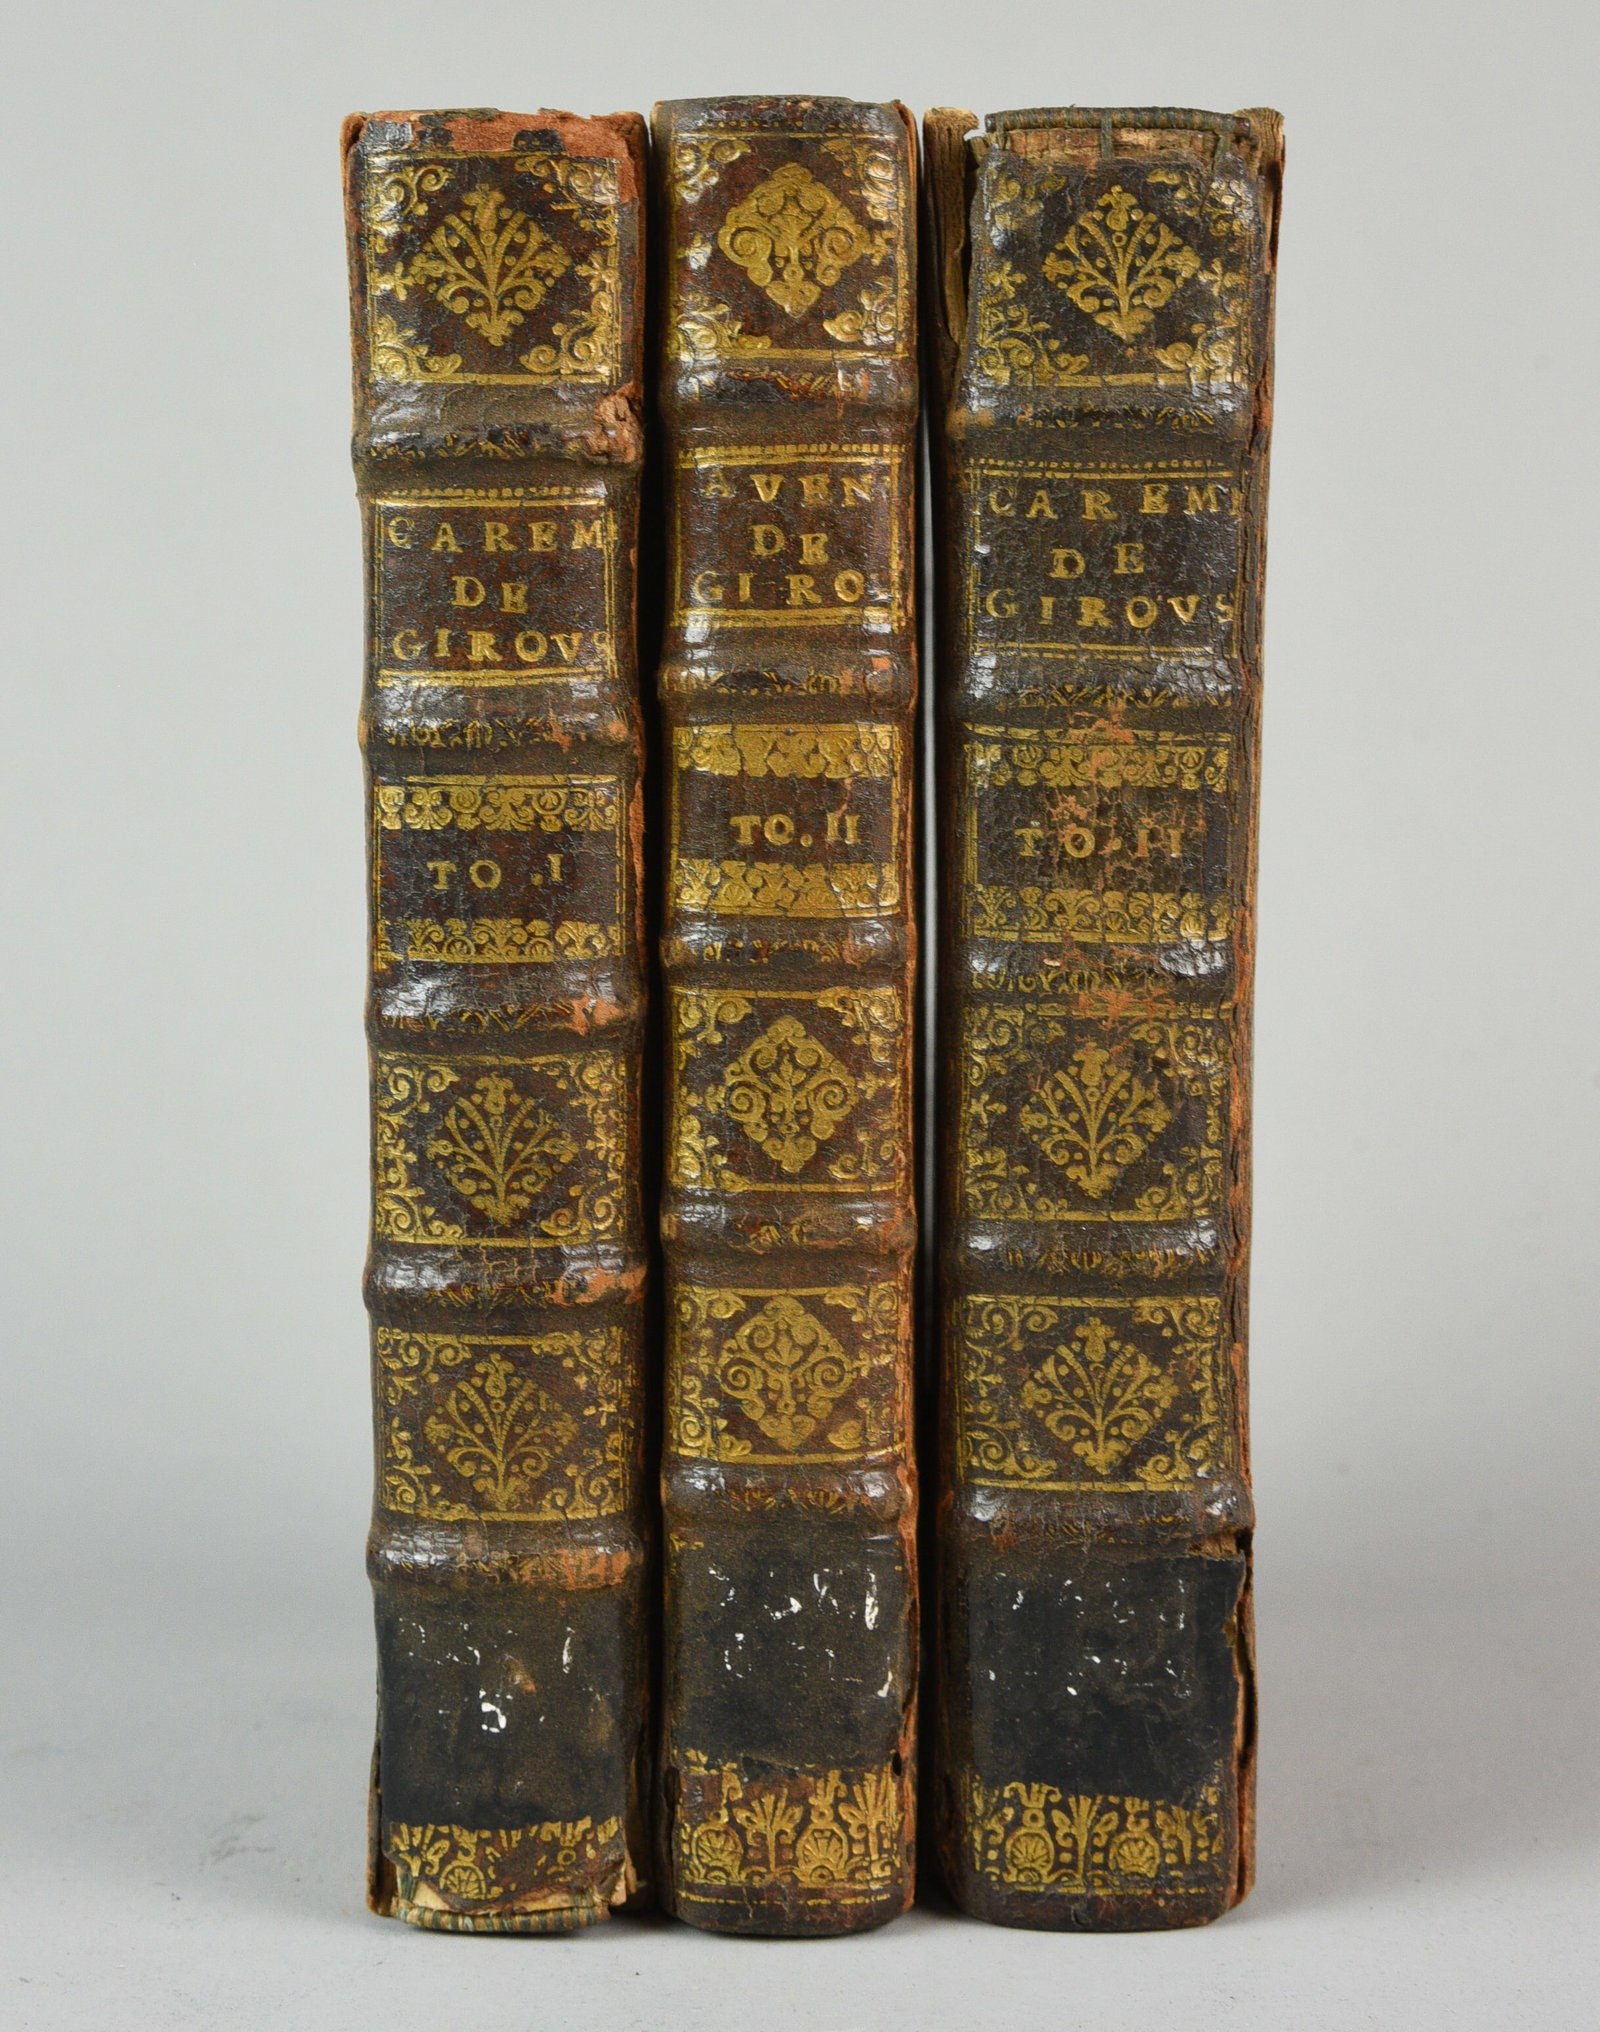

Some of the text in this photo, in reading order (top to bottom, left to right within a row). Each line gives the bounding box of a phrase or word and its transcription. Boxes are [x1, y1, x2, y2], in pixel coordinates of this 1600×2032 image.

[749, 524, 829, 565] DE
[1050, 543, 1144, 579] DE
[452, 575, 529, 614] DE
